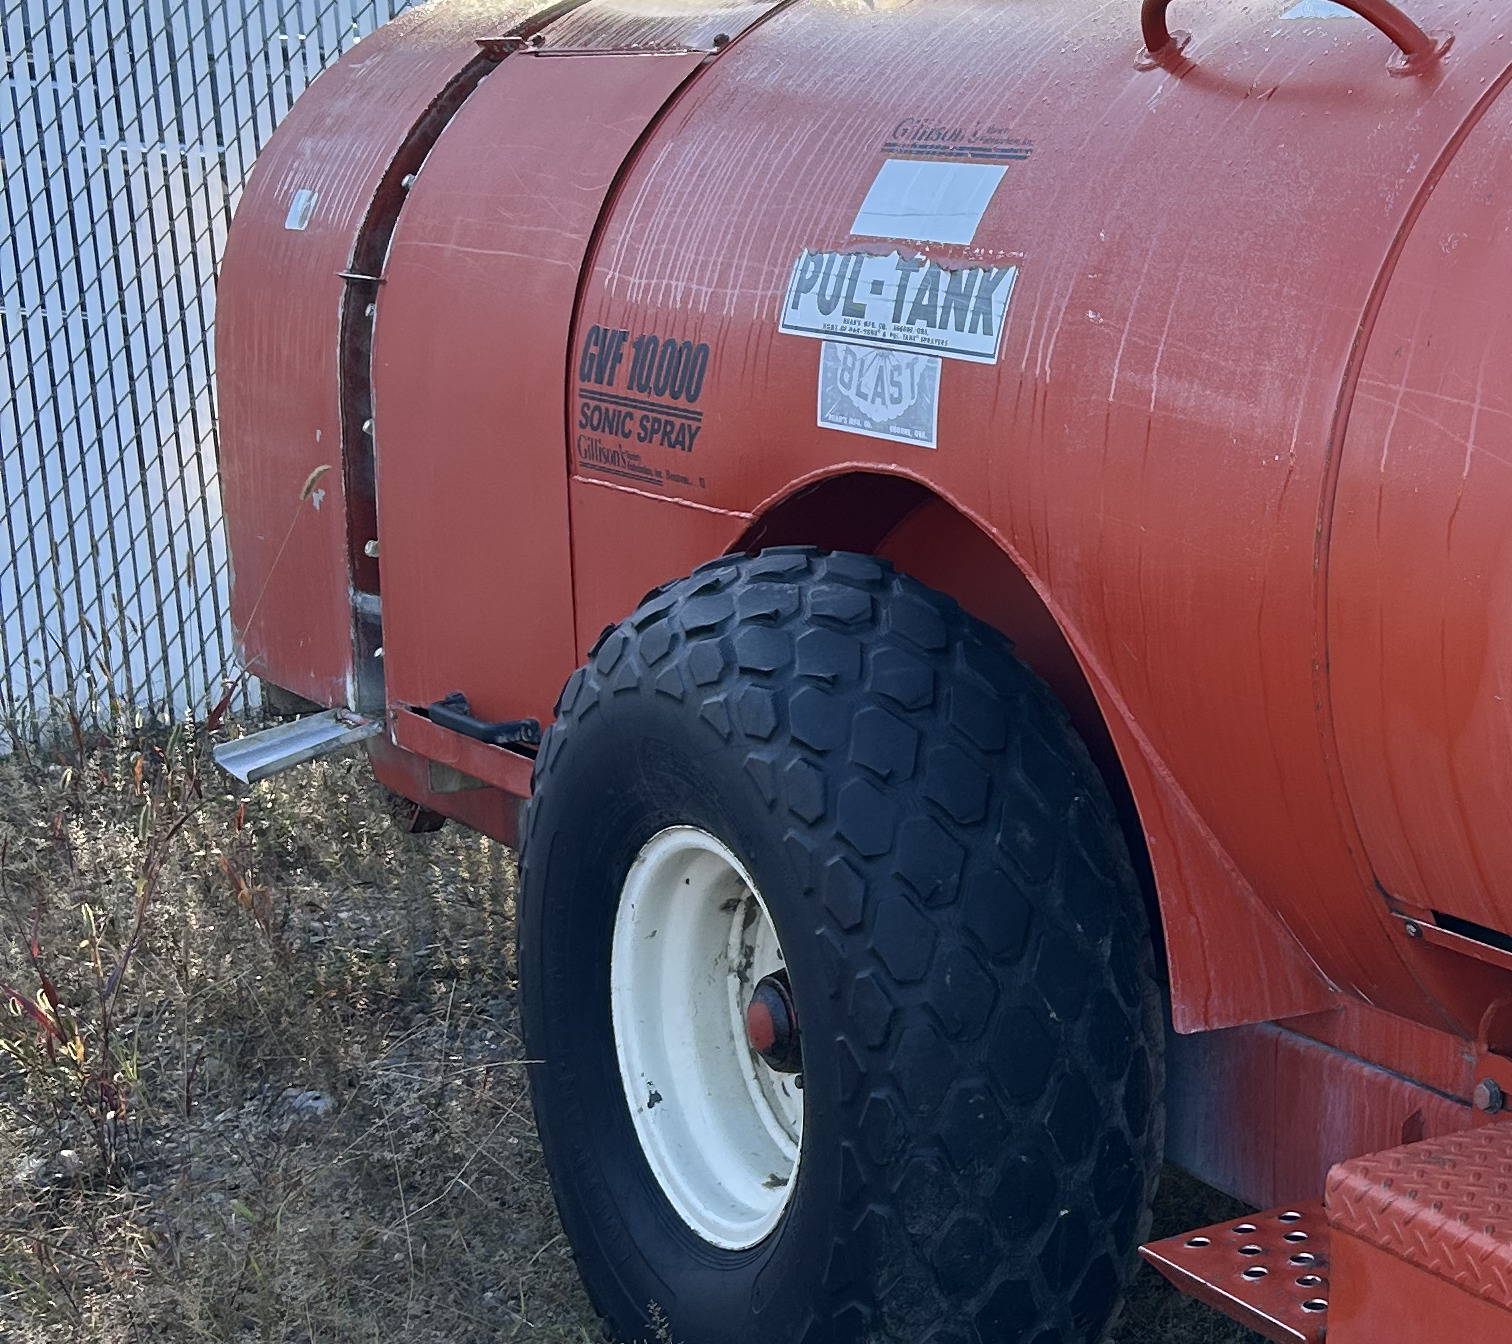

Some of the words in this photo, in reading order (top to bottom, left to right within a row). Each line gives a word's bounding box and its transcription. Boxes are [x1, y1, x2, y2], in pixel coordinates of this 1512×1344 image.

[791, 252, 1008, 336] PUL-TANK
[580, 324, 630, 386] GVF
[627, 334, 710, 404] 10,000
[839, 345, 919, 406] BLAST
[579, 402, 634, 439] SONIC
[637, 414, 702, 453] SPRAY
